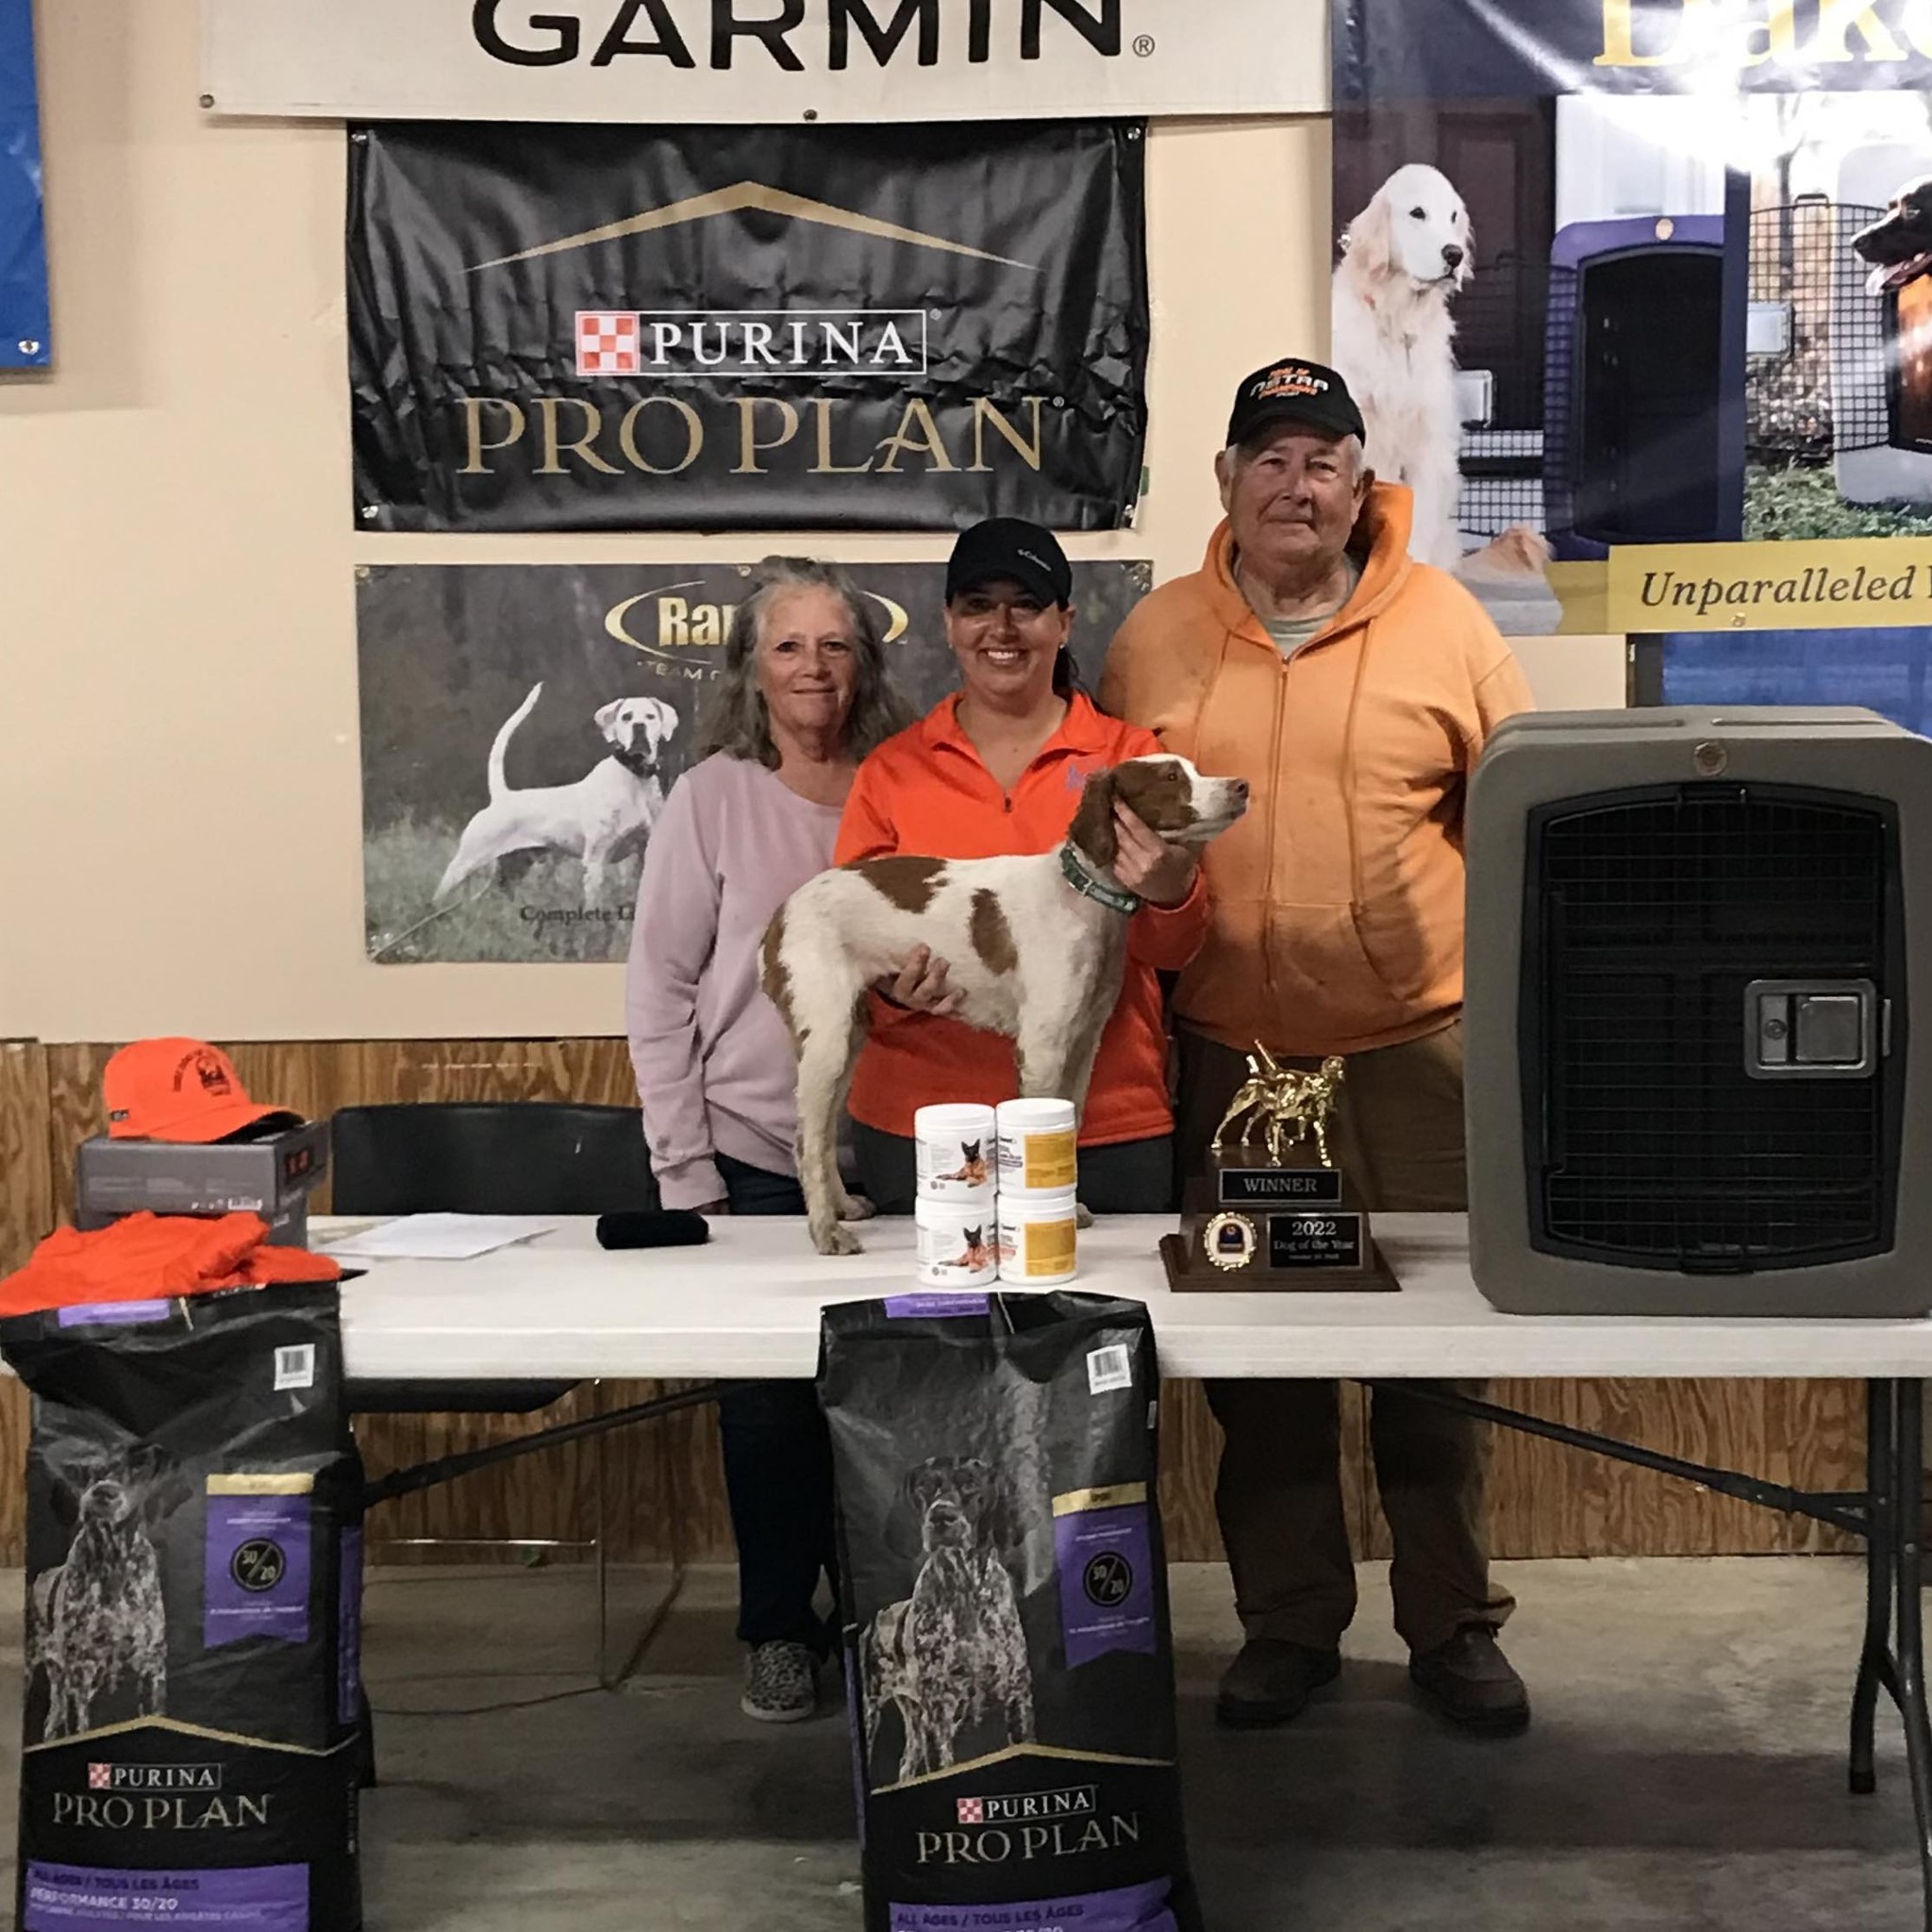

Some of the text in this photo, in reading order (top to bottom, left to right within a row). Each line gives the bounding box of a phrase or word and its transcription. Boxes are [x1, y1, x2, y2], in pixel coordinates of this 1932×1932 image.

[473, 0, 1122, 71] GARMIN
[649, 321, 912, 366] PURINA
[455, 395, 1049, 474] PRO PLAN
[1641, 565, 1917, 615] Unparalleled
[521, 904, 611, 926] Complete
[1243, 1177, 1318, 1192] WINNER
[1291, 1221, 1337, 1236] 2022
[1274, 1240, 1297, 1252] Dog
[113, 1767, 216, 1787] PURINA
[53, 1791, 274, 1829] PRO PLAN
[986, 1790, 1091, 1820] PURINA
[916, 1812, 1140, 1864] PRO PLAN
[30, 1887, 127, 1908] PERFORMANCE
[897, 1913, 918, 1924] ALL
[923, 1913, 958, 1926] AGES
[973, 1913, 1011, 1924] TOUS
[1016, 1909, 1041, 1923] LES
